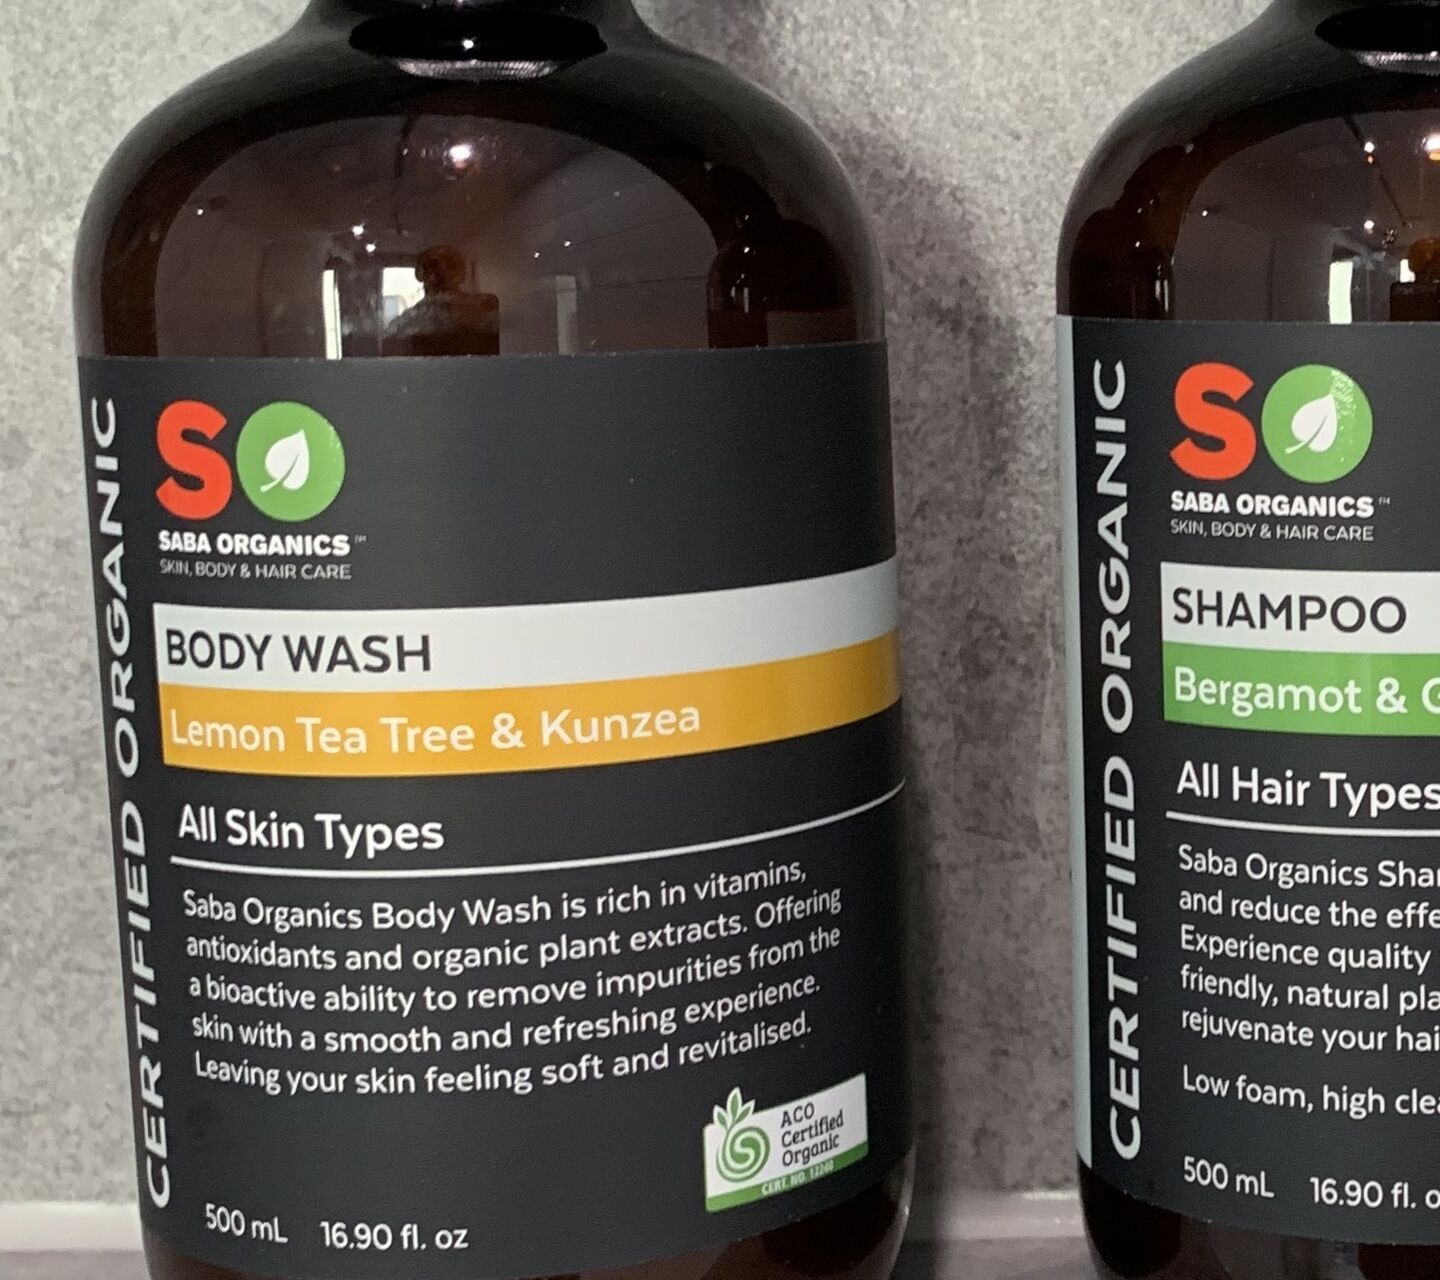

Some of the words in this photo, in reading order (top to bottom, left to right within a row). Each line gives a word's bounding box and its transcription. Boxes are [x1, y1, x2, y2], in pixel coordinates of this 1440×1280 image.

[1171, 490, 1231, 514] SABA
[1235, 493, 1375, 518] ORGANICS
[158, 529, 212, 554] SABA
[216, 532, 351, 557] ORGANICS
[1093, 359, 1134, 734] ORGANIC
[1170, 518, 1208, 538] SKIN,
[1210, 521, 1257, 538] BODY
[1259, 523, 1272, 539] &
[1276, 524, 1320, 540] HAIR
[1323, 524, 1374, 541] CARE
[90, 397, 139, 778] ORGANIC
[159, 558, 193, 577] SKIN,
[194, 560, 237, 578] BODY
[239, 563, 251, 579] &
[254, 563, 297, 579] HAIR
[300, 563, 352, 580] CARE
[1172, 586, 1407, 634] SHAMPOO
[165, 628, 272, 672] BODY
[282, 634, 431, 674] WASH
[1175, 666, 1363, 718] Bergamot
[1375, 676, 1408, 714] &
[171, 708, 286, 753] Lemon
[295, 716, 367, 754] Tea
[378, 716, 475, 754] Tree
[490, 712, 526, 749] &
[540, 706, 700, 747] Kunzea
[1176, 760, 1219, 799] All
[1232, 765, 1311, 807] Hair
[178, 803, 217, 843] All
[225, 808, 305, 849] Skin
[314, 813, 445, 859] Types
[1178, 843, 1238, 877] Saba
[1245, 852, 1369, 890] Organics
[182, 888, 237, 922] Saba
[242, 897, 363, 934] Organics
[372, 900, 456, 934] Body
[461, 894, 552, 926] Wash
[561, 892, 587, 919] is
[596, 884, 651, 915] rich
[660, 880, 686, 907] in
[693, 861, 806, 901] vitamins,
[186, 934, 338, 971] antioxidants
[345, 943, 403, 971] and
[412, 938, 529, 976] organic
[539, 930, 621, 969] plant
[629, 913, 748, 952] extracts.
[754, 888, 842, 929] Offering
[1180, 923, 1320, 966] Experience
[1327, 942, 1432, 976] quality
[1103, 755, 1141, 1160] CERTIFIED
[120, 800, 171, 1209] CERTIFIED
[1180, 963, 1279, 1008] friendly,
[1287, 983, 1389, 1010] natural
[195, 1050, 282, 1096] Leaving
[286, 1070, 348, 1096] your
[354, 1066, 416, 1094] skin
[424, 1063, 533, 1095] feeling
[541, 1053, 604, 1086] soft
[612, 1042, 669, 1077] and
[678, 1005, 812, 1066] revitalised.
[1182, 1007, 1315, 1047] rejuvenate
[1321, 1028, 1388, 1054] your
[780, 1102, 815, 1129] ACO
[1183, 1064, 1230, 1098] Low
[1235, 1074, 1314, 1113] foam,
[1322, 1084, 1386, 1120] high
[781, 1109, 844, 1148] Certified
[782, 1134, 840, 1167] Organic
[1184, 1155, 1229, 1190] 500
[1235, 1170, 1275, 1198] mL
[1309, 1176, 1384, 1208] 16.90
[1390, 1181, 1417, 1209] fl.
[205, 1202, 246, 1237] 500
[251, 1216, 289, 1244] mL
[320, 1221, 393, 1251] 16.90
[400, 1223, 427, 1250] fl.
[434, 1228, 469, 1250] oz
